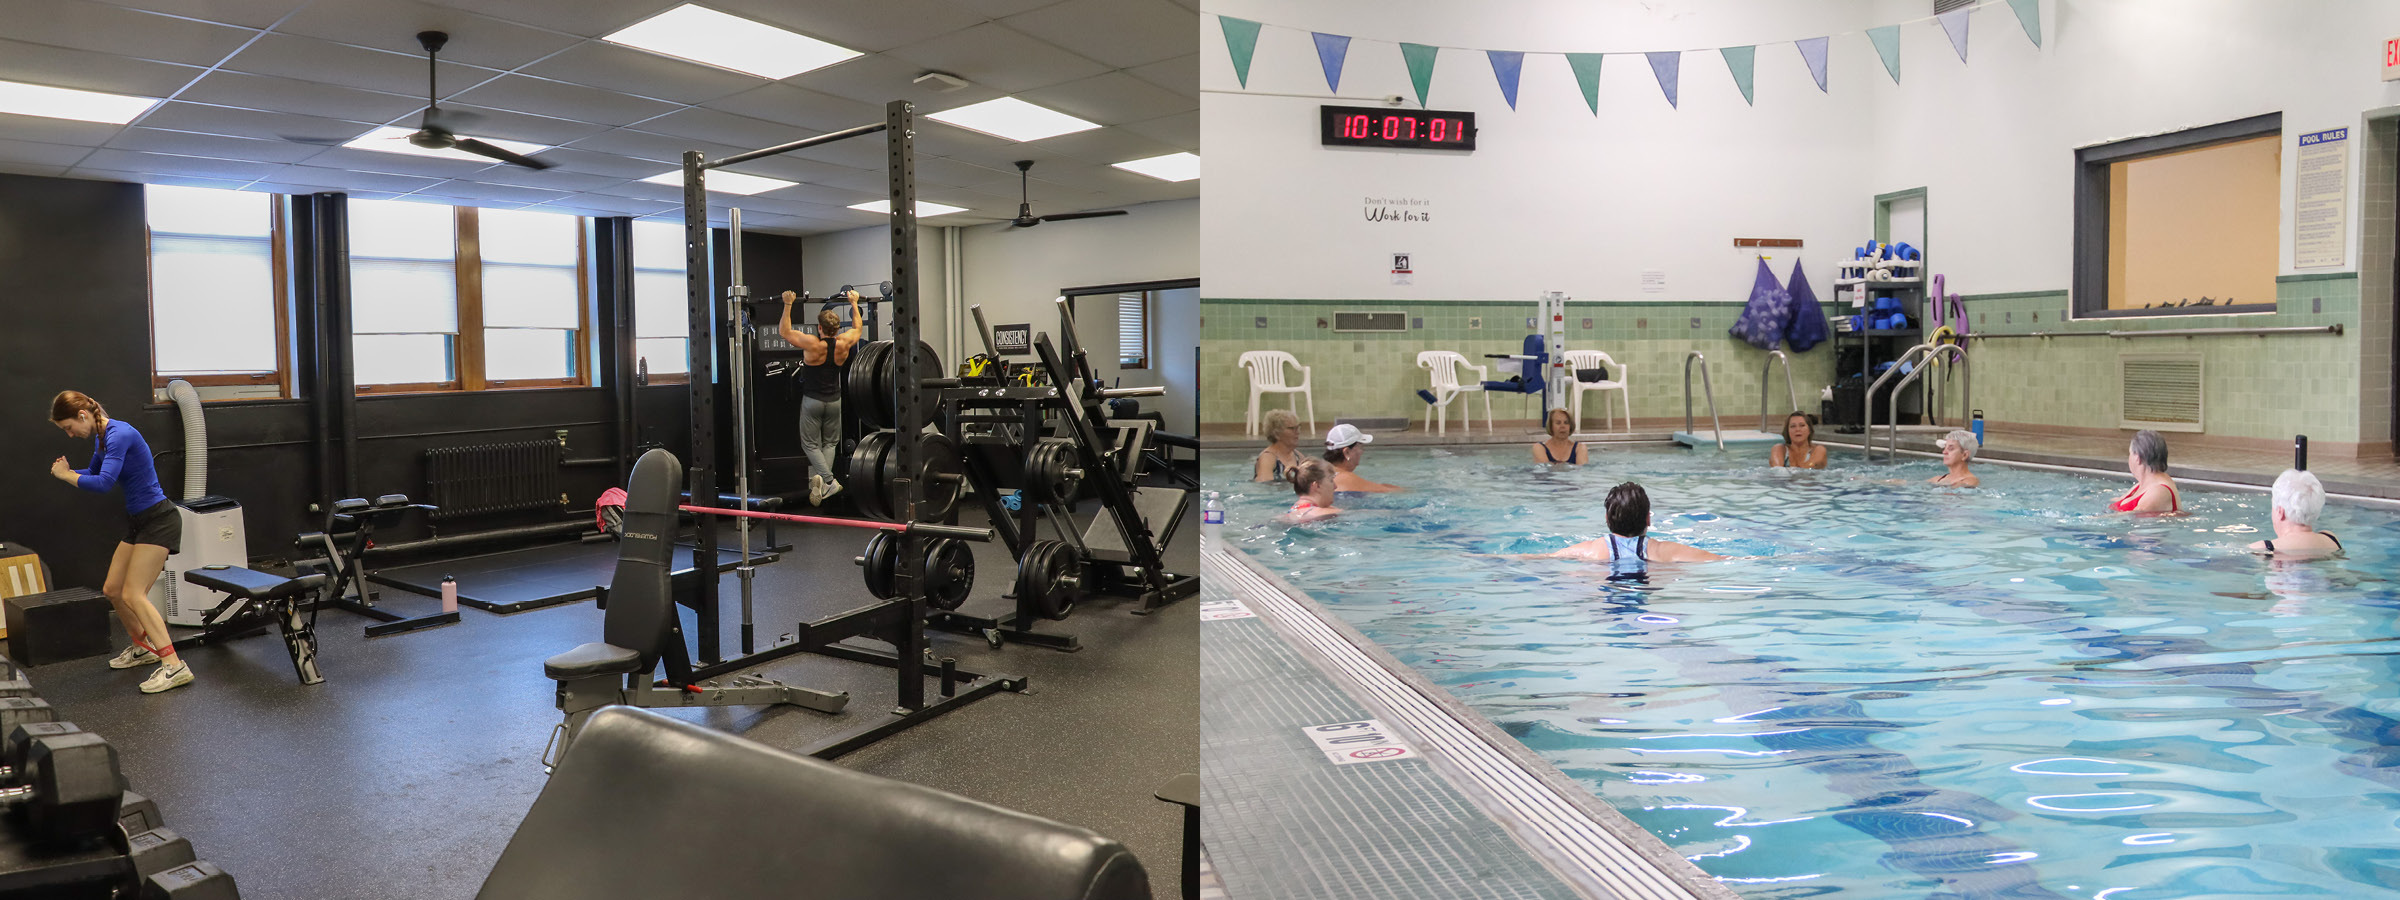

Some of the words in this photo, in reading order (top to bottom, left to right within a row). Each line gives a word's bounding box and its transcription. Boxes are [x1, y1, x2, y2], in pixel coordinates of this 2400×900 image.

[1344, 115, 1463, 142] 10:07:01
[2302, 135, 2320, 144] POOL
[2322, 130, 2345, 141] RULES
[1364, 197, 1387, 205] Don't
[1389, 198, 1408, 206] wish
[1410, 198, 1422, 206] for
[1423, 198, 1430, 206] it
[1364, 206, 1401, 222] Work
[1404, 210, 1420, 222] for
[1421, 212, 1430, 222] it
[996, 330, 1027, 345] CONSISTENCY
